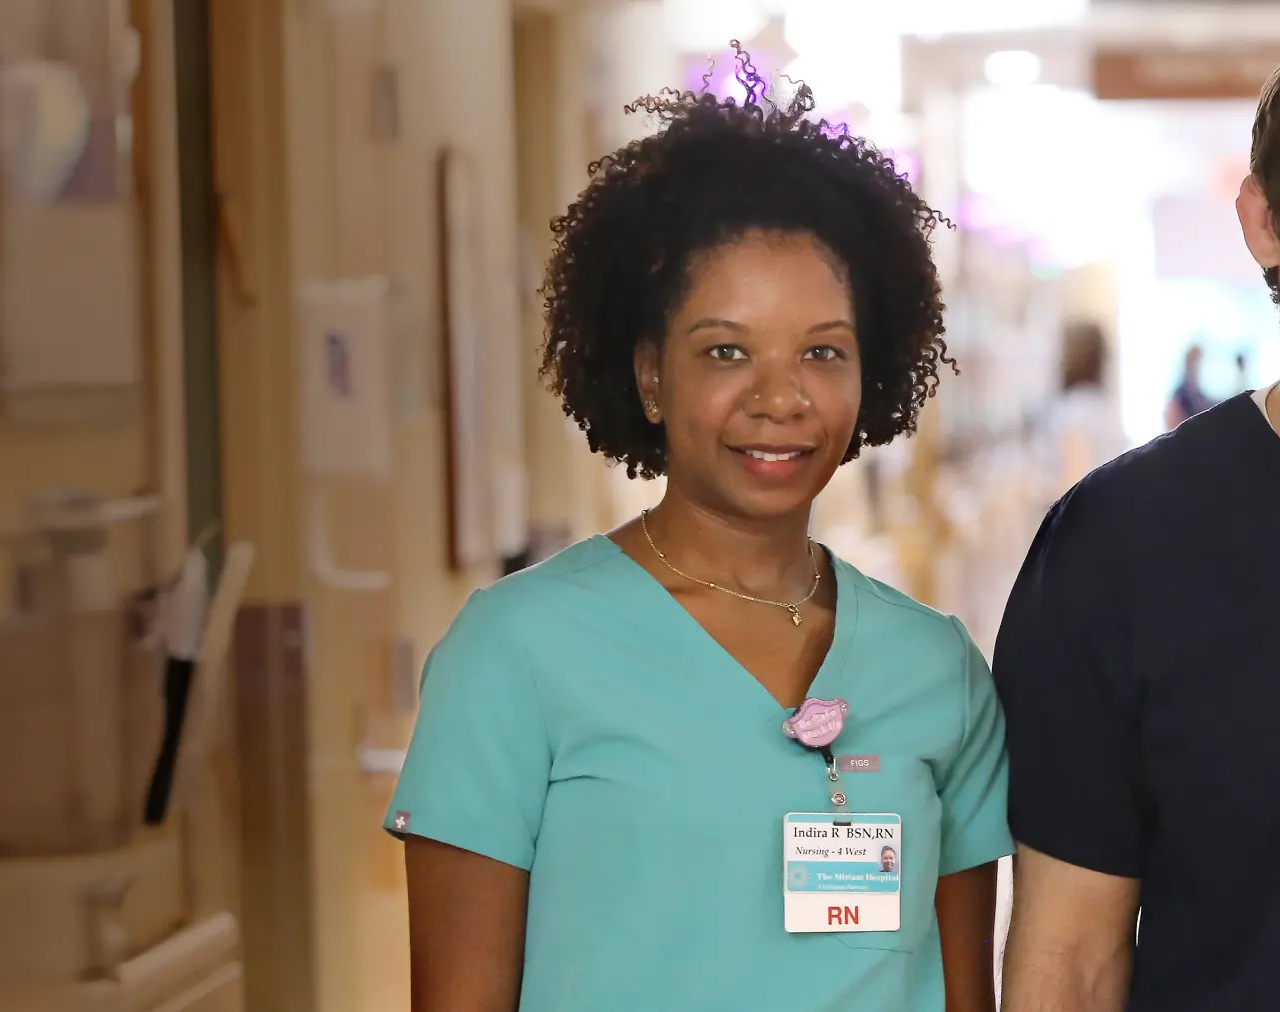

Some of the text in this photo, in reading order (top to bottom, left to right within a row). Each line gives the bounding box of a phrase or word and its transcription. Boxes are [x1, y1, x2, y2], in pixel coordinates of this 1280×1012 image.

[850, 759, 870, 767] FIGS
[793, 827, 894, 840] Indira R BSN,RN
[795, 846, 830, 858] Nursing
[837, 847, 843, 856] 4
[845, 847, 867, 856] West
[817, 872, 833, 881] The
[865, 873, 899, 883] Hospital
[827, 905, 859, 925] RN
